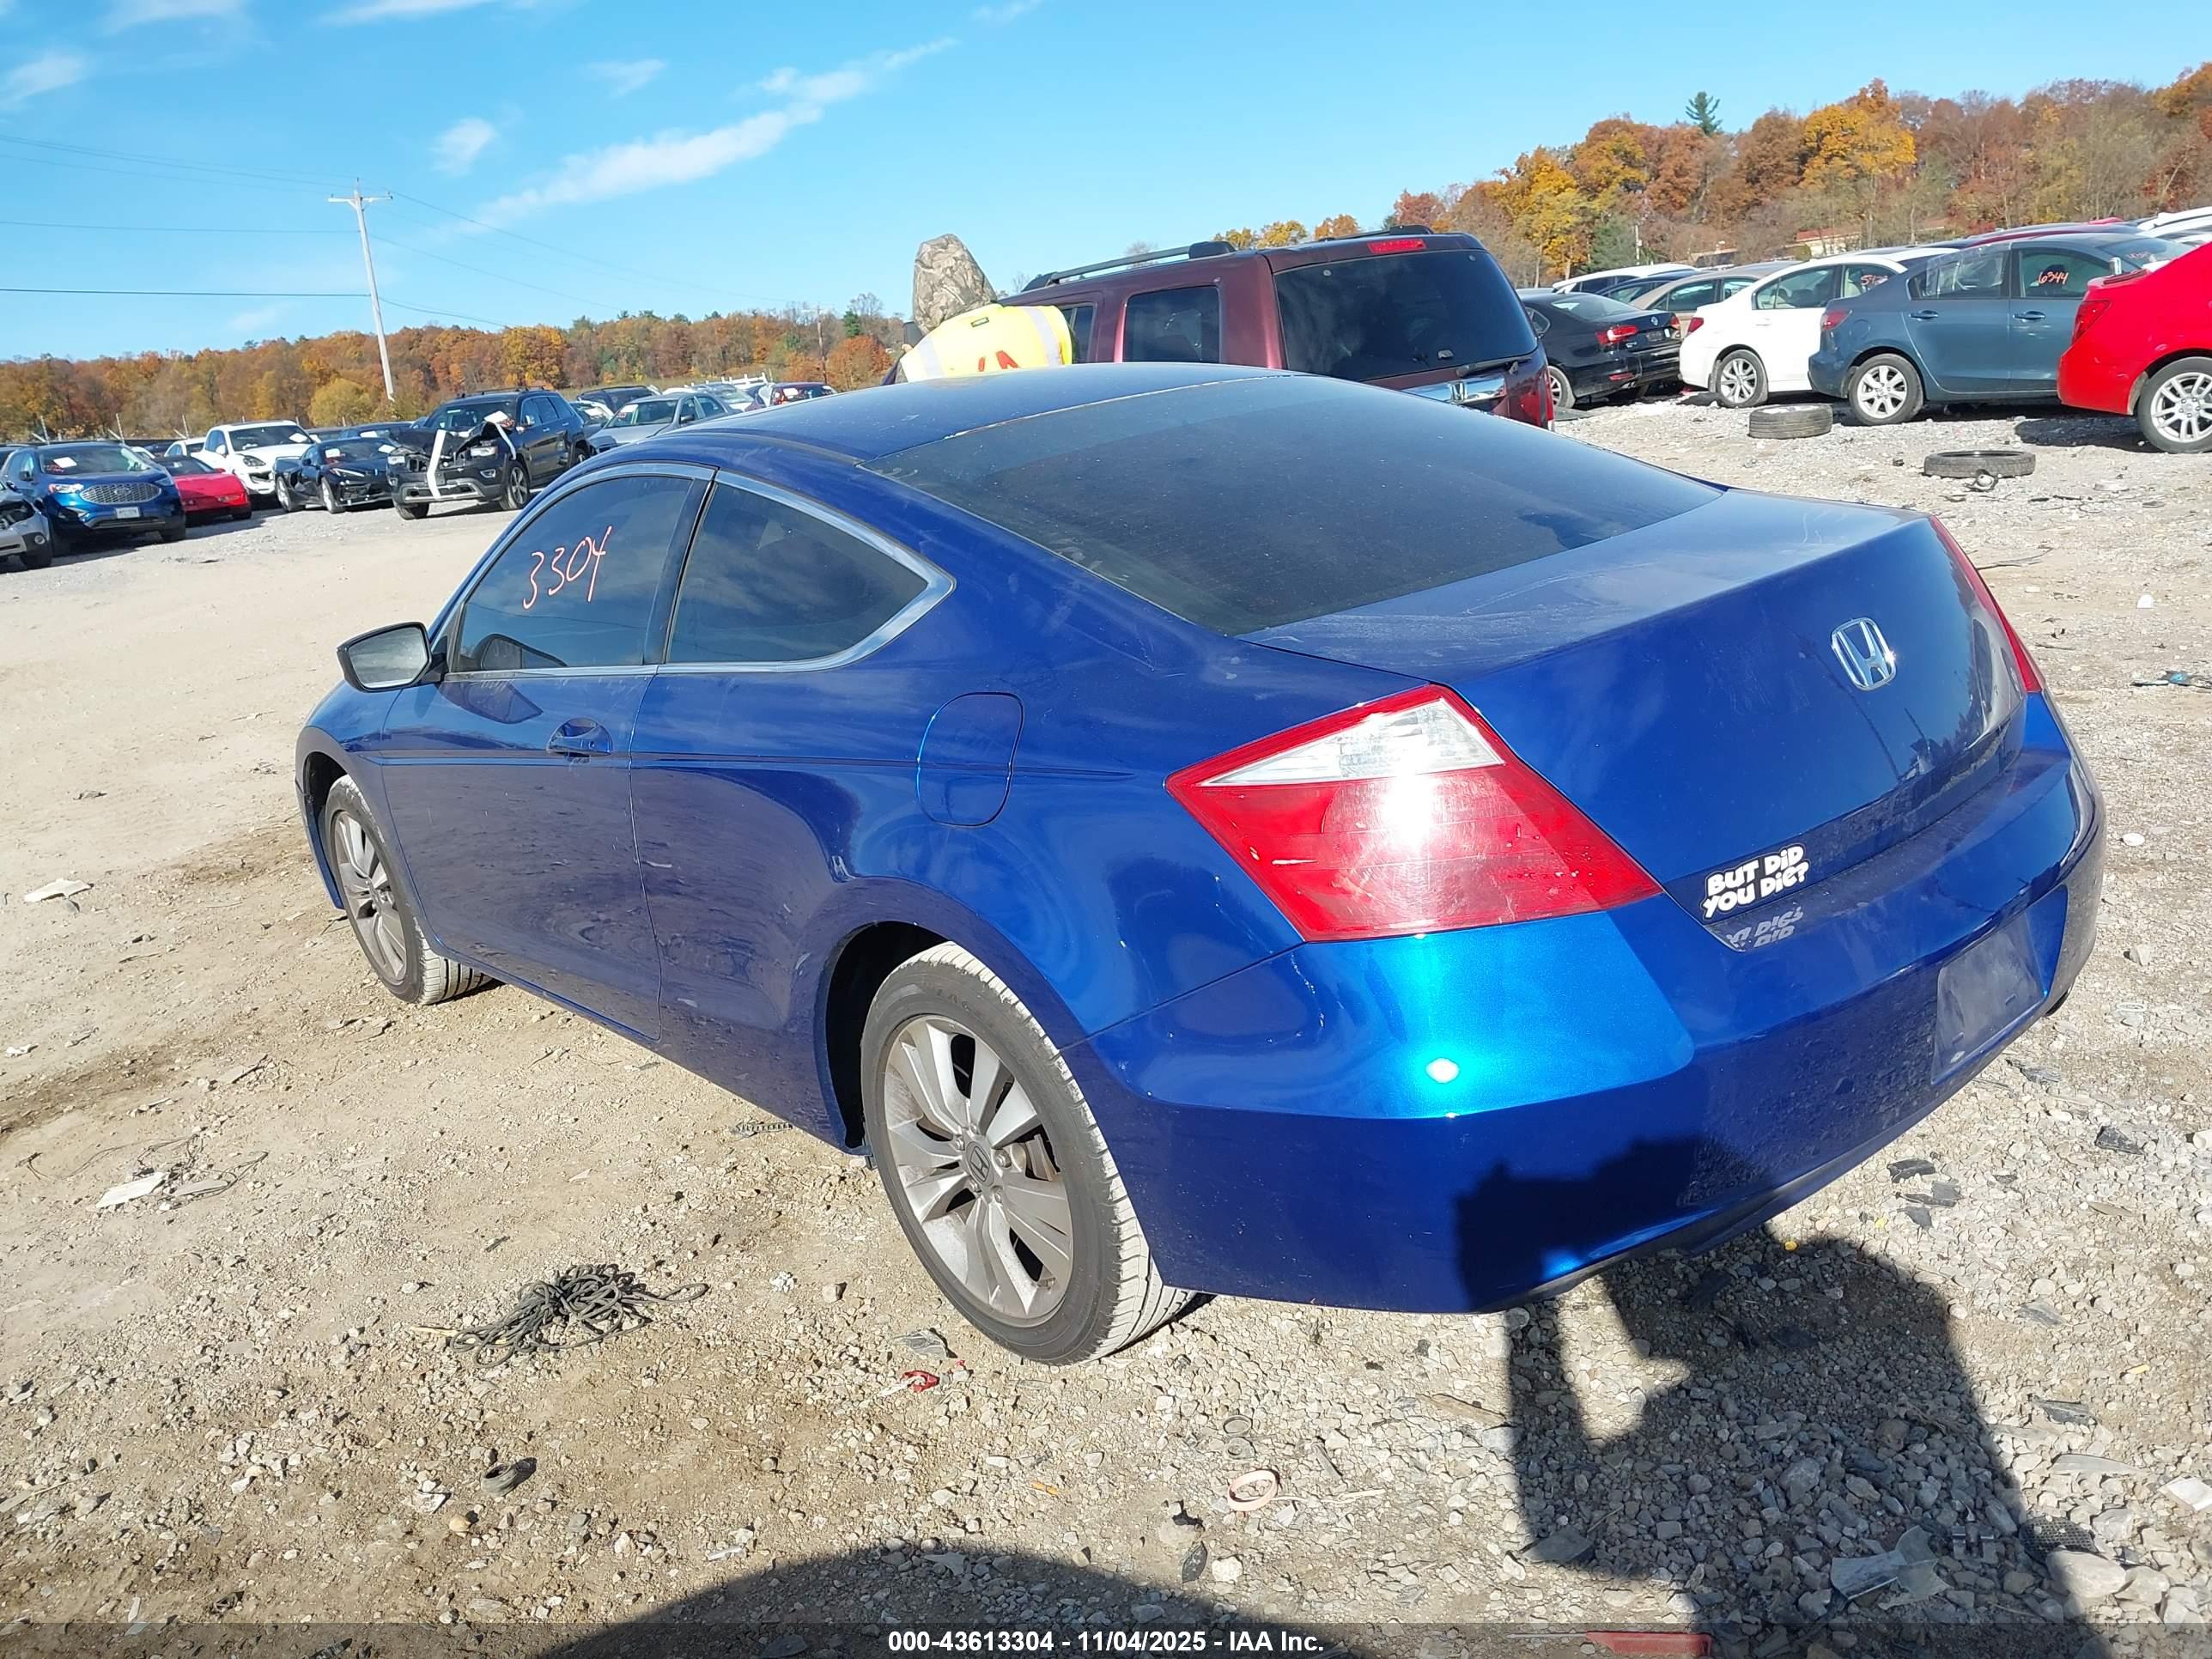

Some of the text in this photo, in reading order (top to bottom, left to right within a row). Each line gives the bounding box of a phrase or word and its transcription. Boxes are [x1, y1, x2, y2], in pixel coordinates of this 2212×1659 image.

[522, 525, 613, 611] 3304
[1706, 857, 1760, 897] BUT
[1702, 883, 1756, 920] YOU
